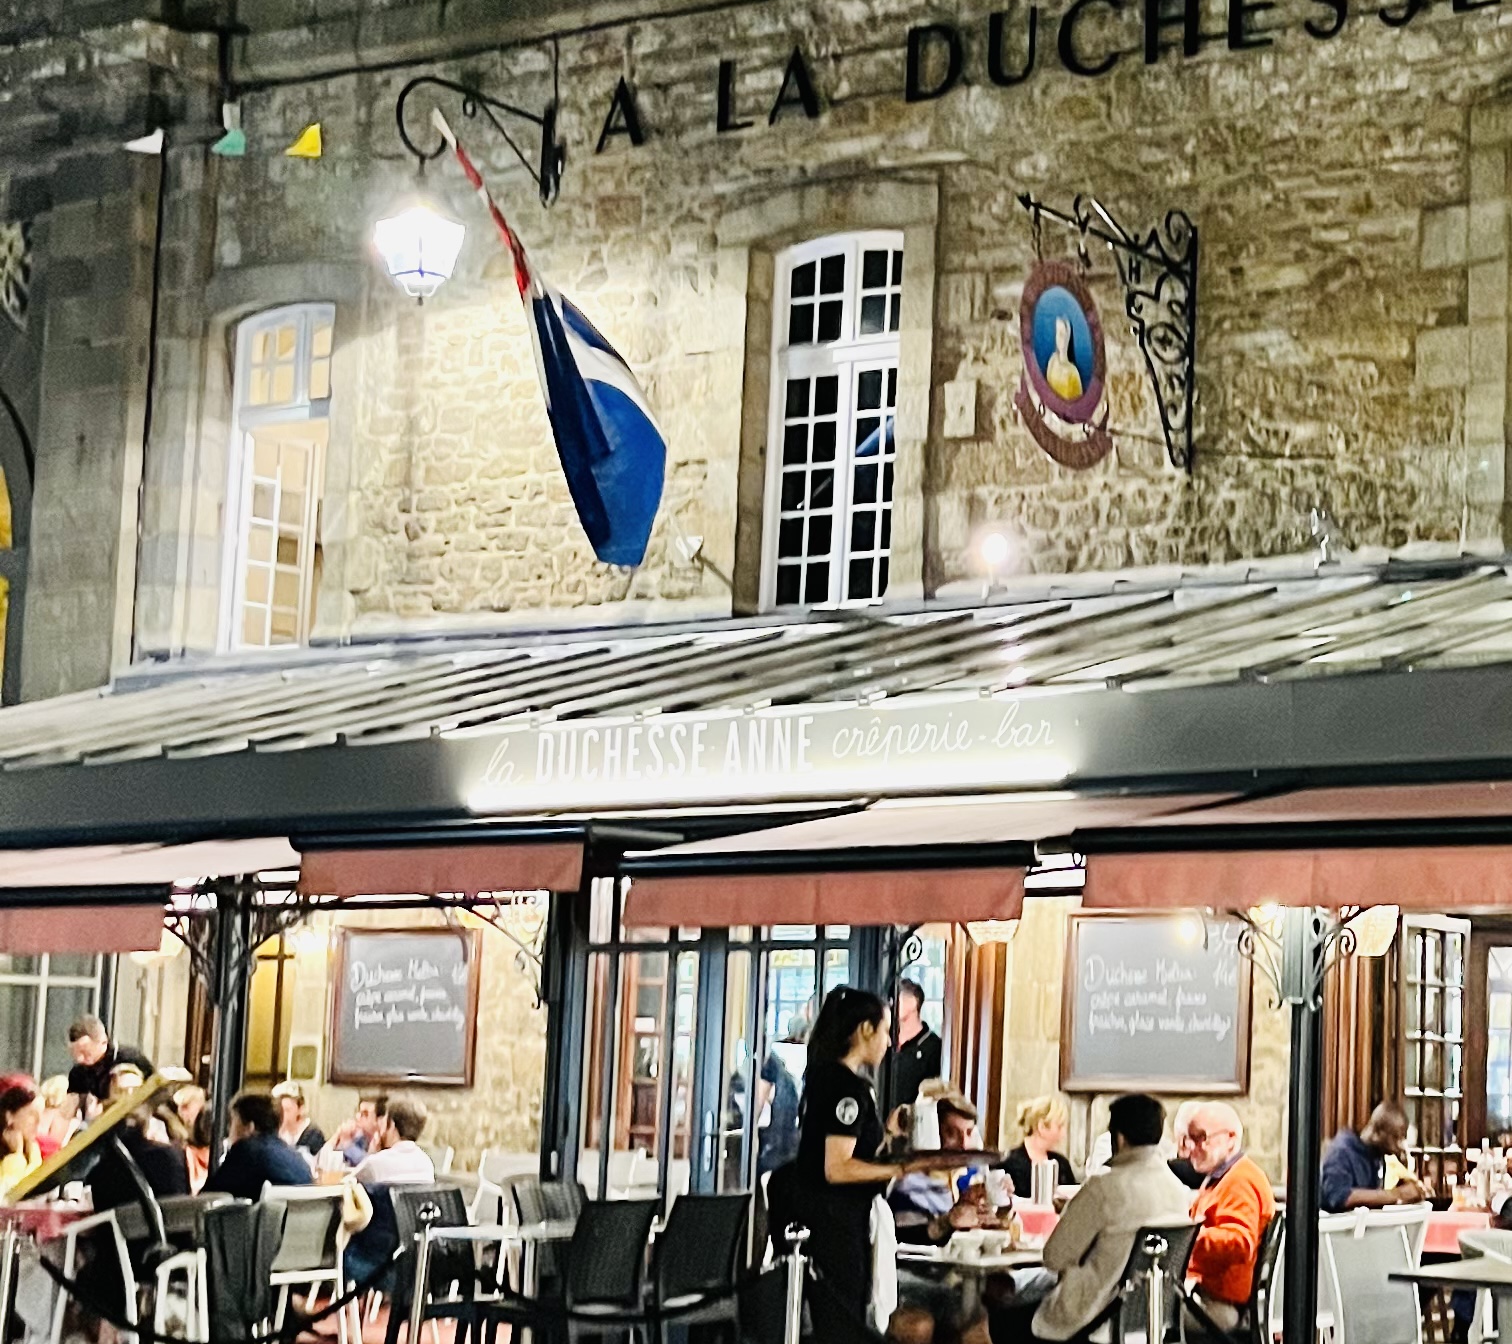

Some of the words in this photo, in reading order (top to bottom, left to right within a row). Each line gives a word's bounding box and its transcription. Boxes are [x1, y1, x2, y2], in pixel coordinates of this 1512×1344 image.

[595, 75, 645, 153] A
[715, 45, 820, 133] LA
[480, 737, 525, 787] la
[535, 722, 708, 784] DUCHESSE
[722, 715, 815, 777] ANNE
